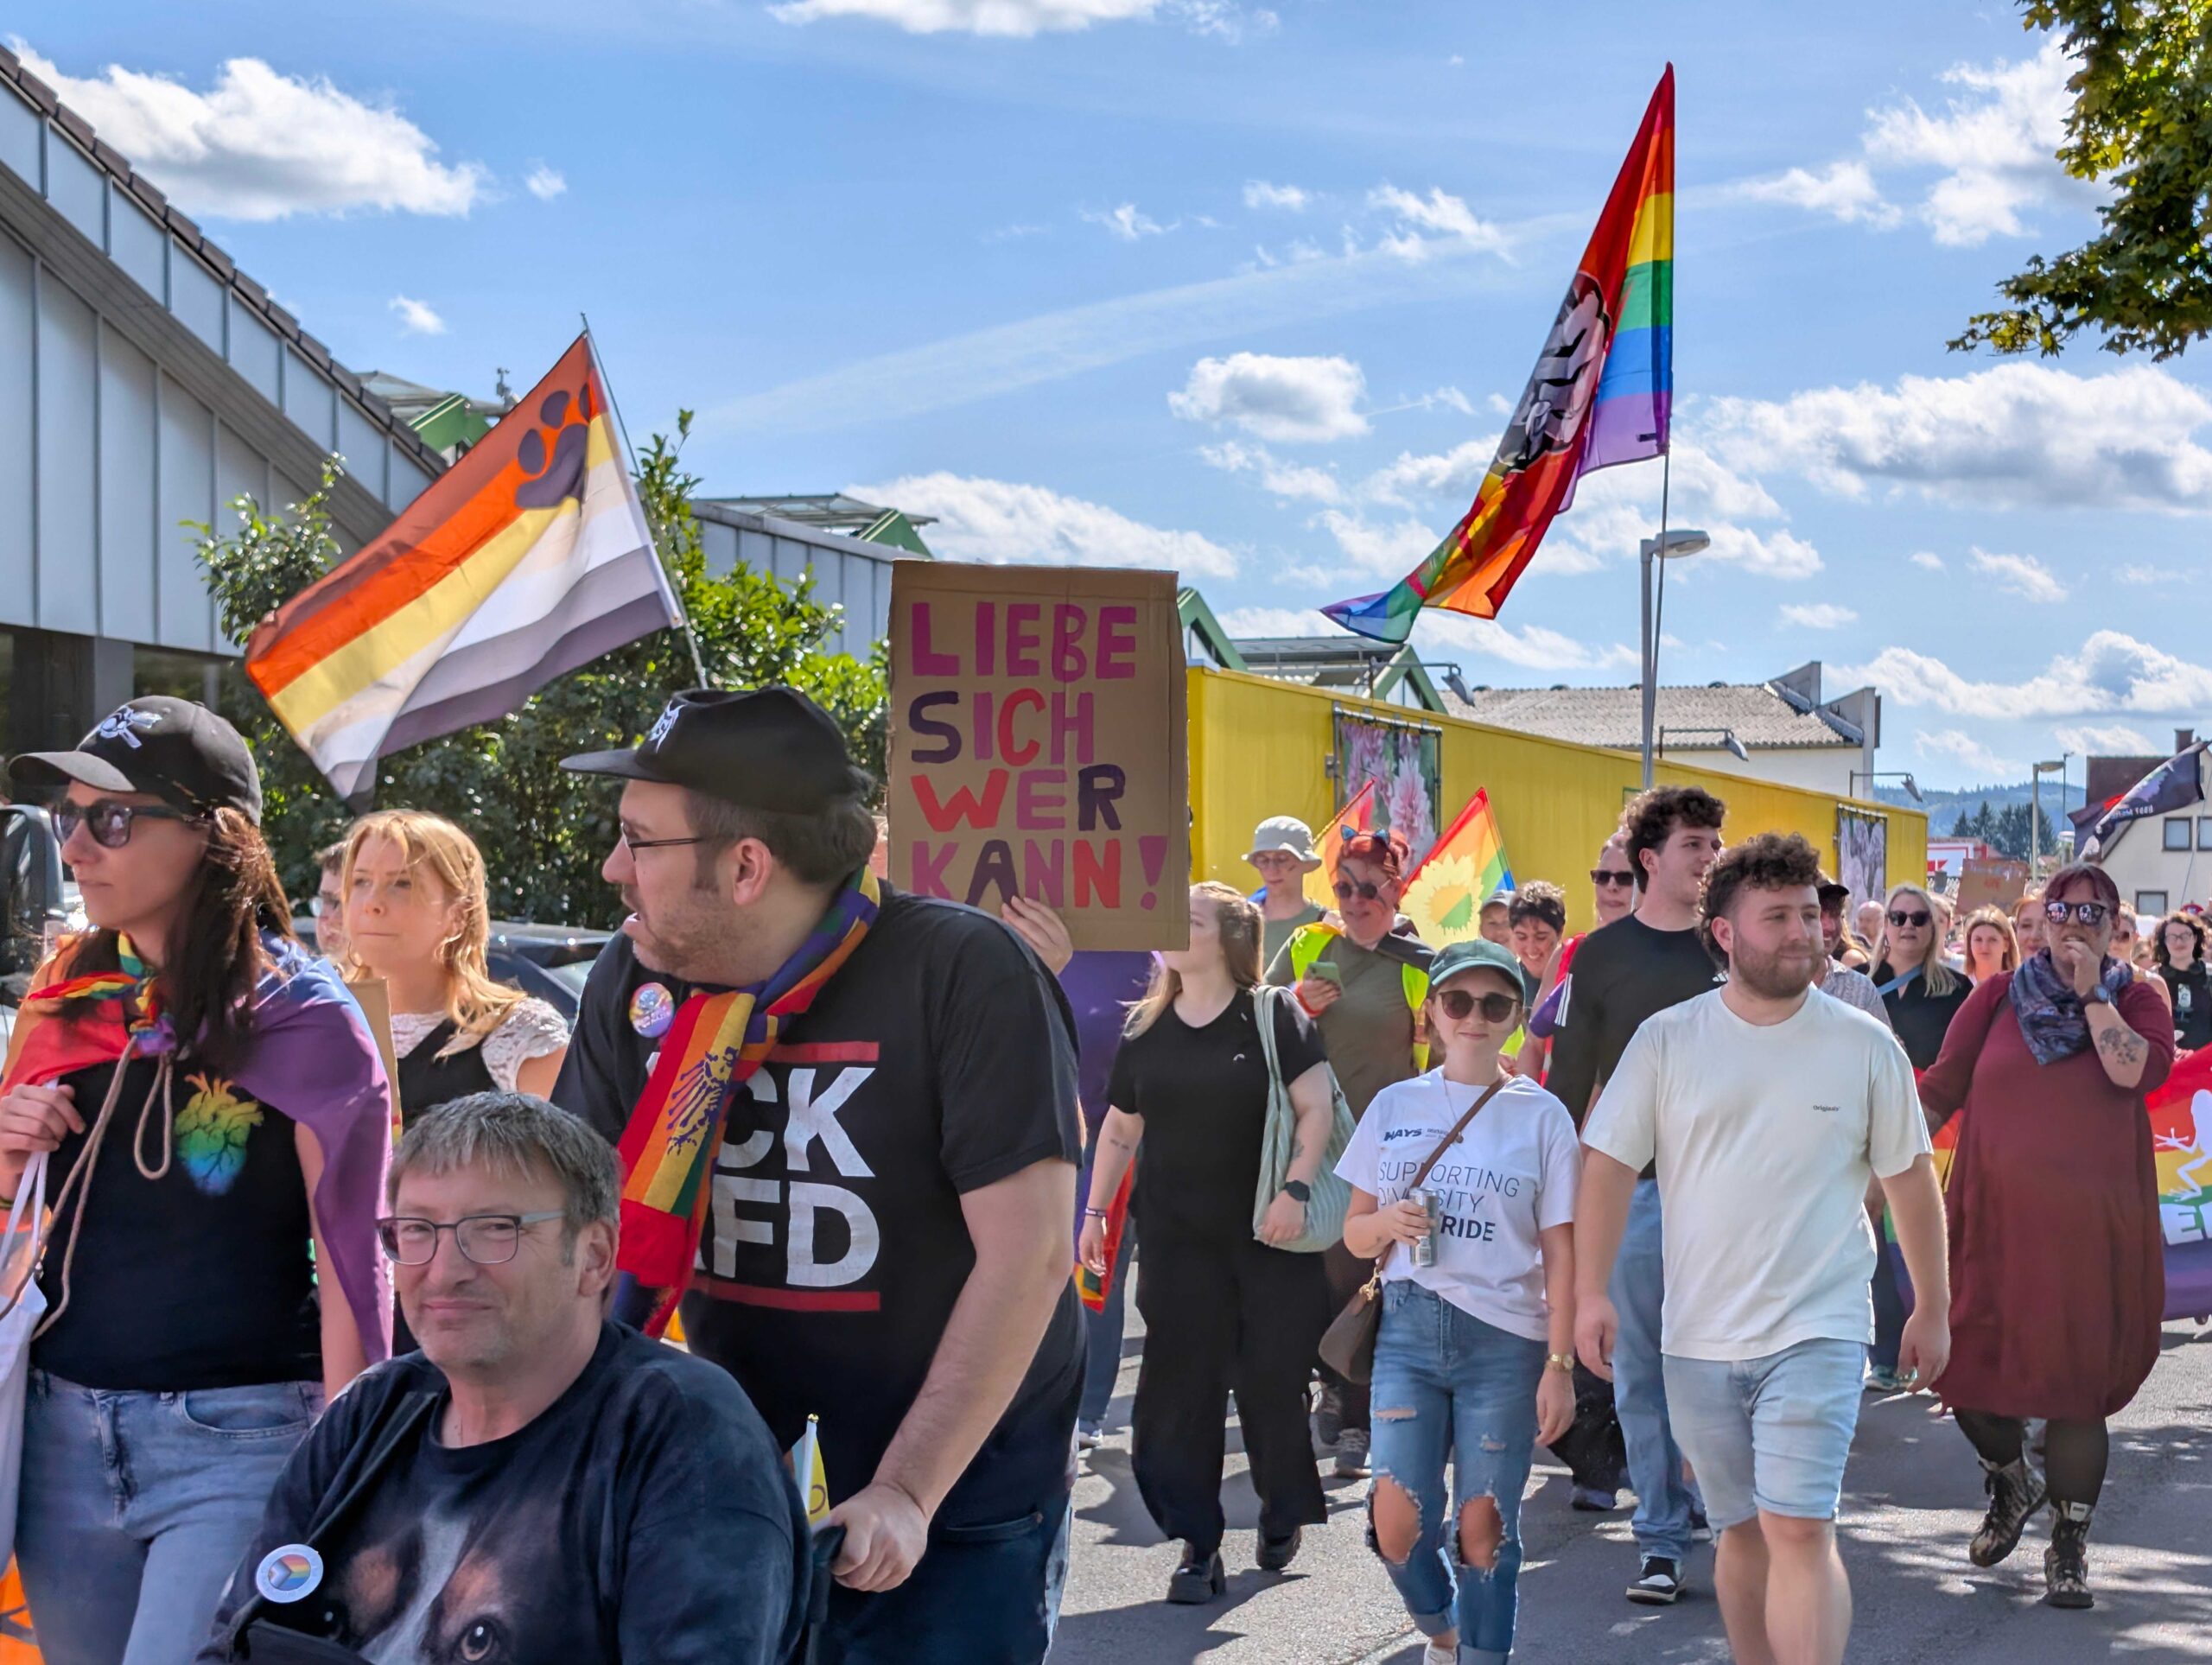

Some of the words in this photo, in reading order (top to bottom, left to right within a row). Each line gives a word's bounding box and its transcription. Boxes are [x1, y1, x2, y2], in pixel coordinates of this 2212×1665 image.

[912, 602, 1136, 682] LIEBE
[909, 688, 1094, 766] SICH
[911, 764, 1126, 832] WER
[645, 1052, 877, 1178] CK
[1379, 1161, 1520, 1198] SUPORTING
[694, 1173, 880, 1287] FD
[1440, 1211, 1496, 1242] RIDE
